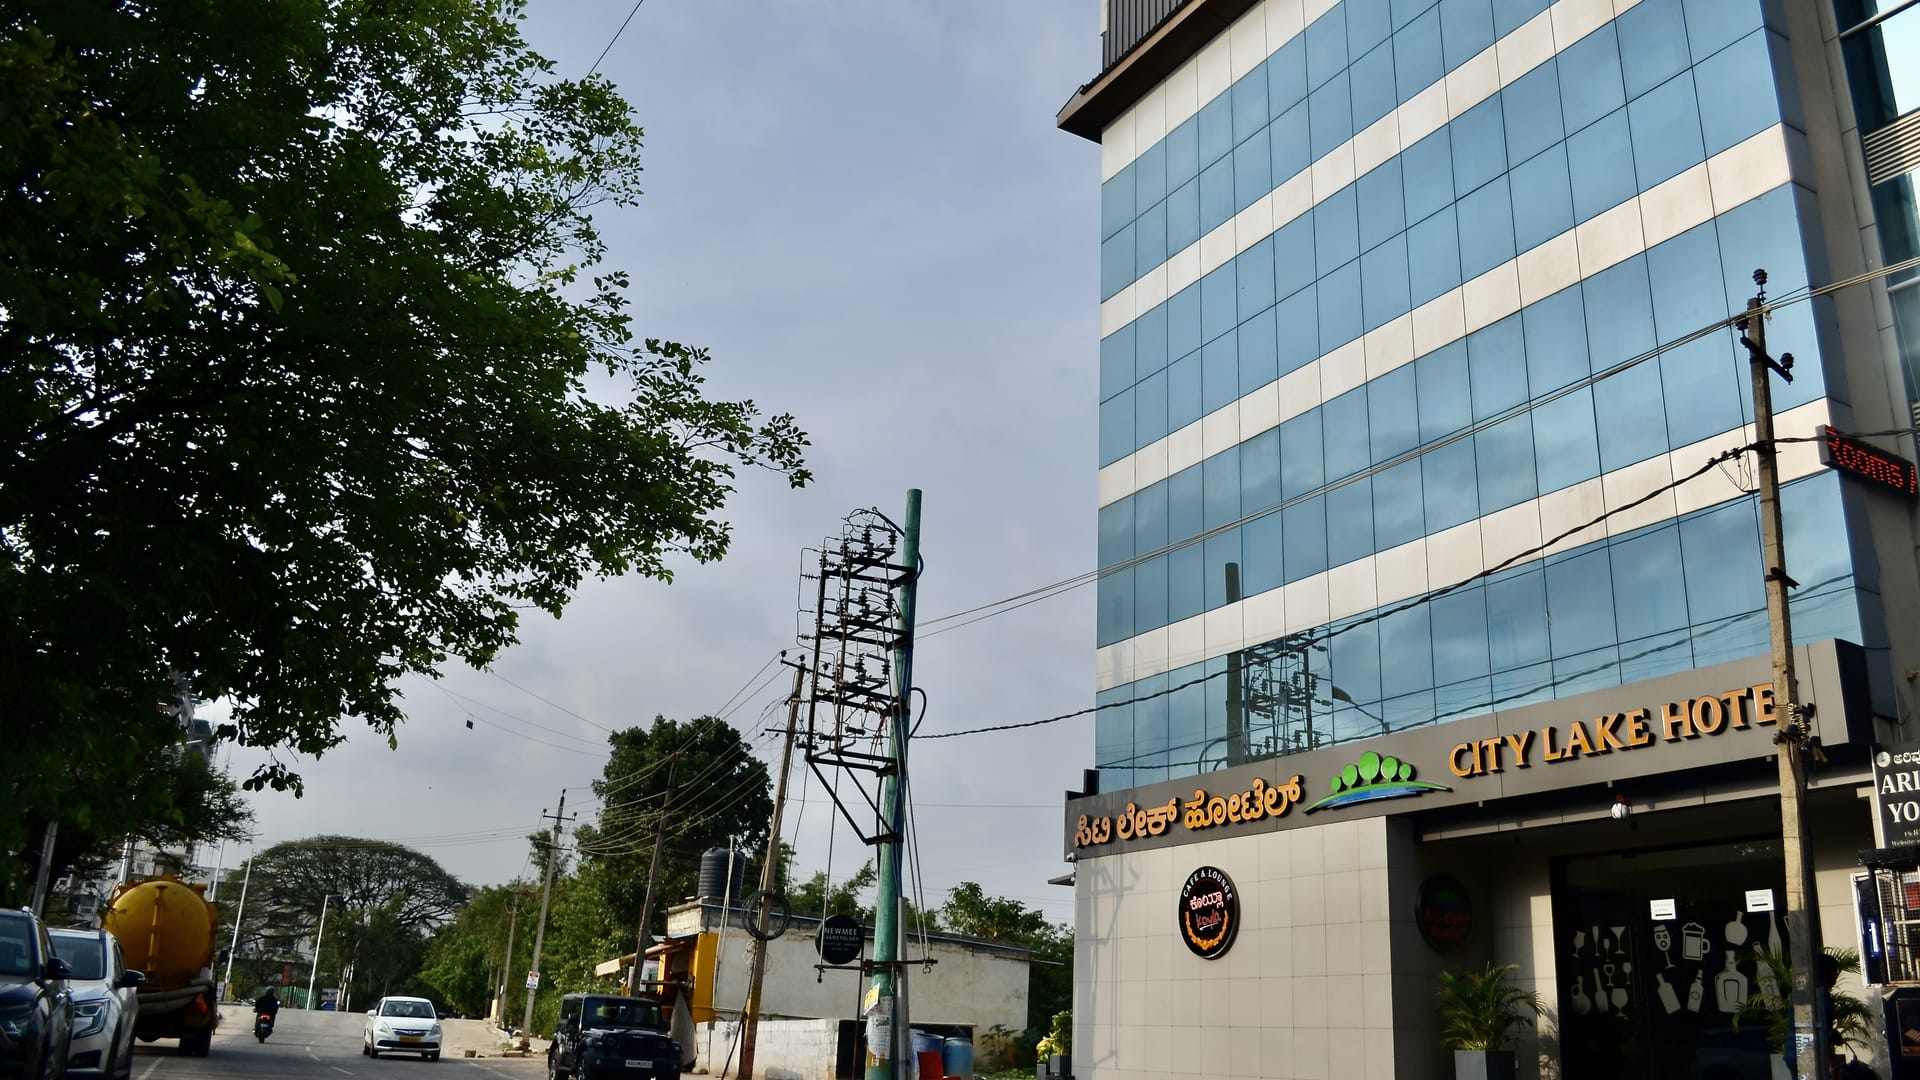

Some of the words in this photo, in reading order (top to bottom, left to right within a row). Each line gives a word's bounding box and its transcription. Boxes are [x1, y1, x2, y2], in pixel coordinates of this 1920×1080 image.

[1449, 730, 1534, 777] CITY
[1541, 708, 1652, 762] LAKE
[1660, 682, 1777, 741] HOTE
[1074, 814, 1111, 847] ಸಿಟಿ
[1116, 797, 1178, 840] ಲೇಕ್
[1183, 775, 1302, 829] ಹೋಟೆಲ್
[1887, 800, 1920, 823] YO
[1183, 873, 1199, 898] CAFE
[1200, 869, 1206, 878] &
[1208, 869, 1233, 901] LOUNGE
[824, 927, 857, 936] NEWMEE
